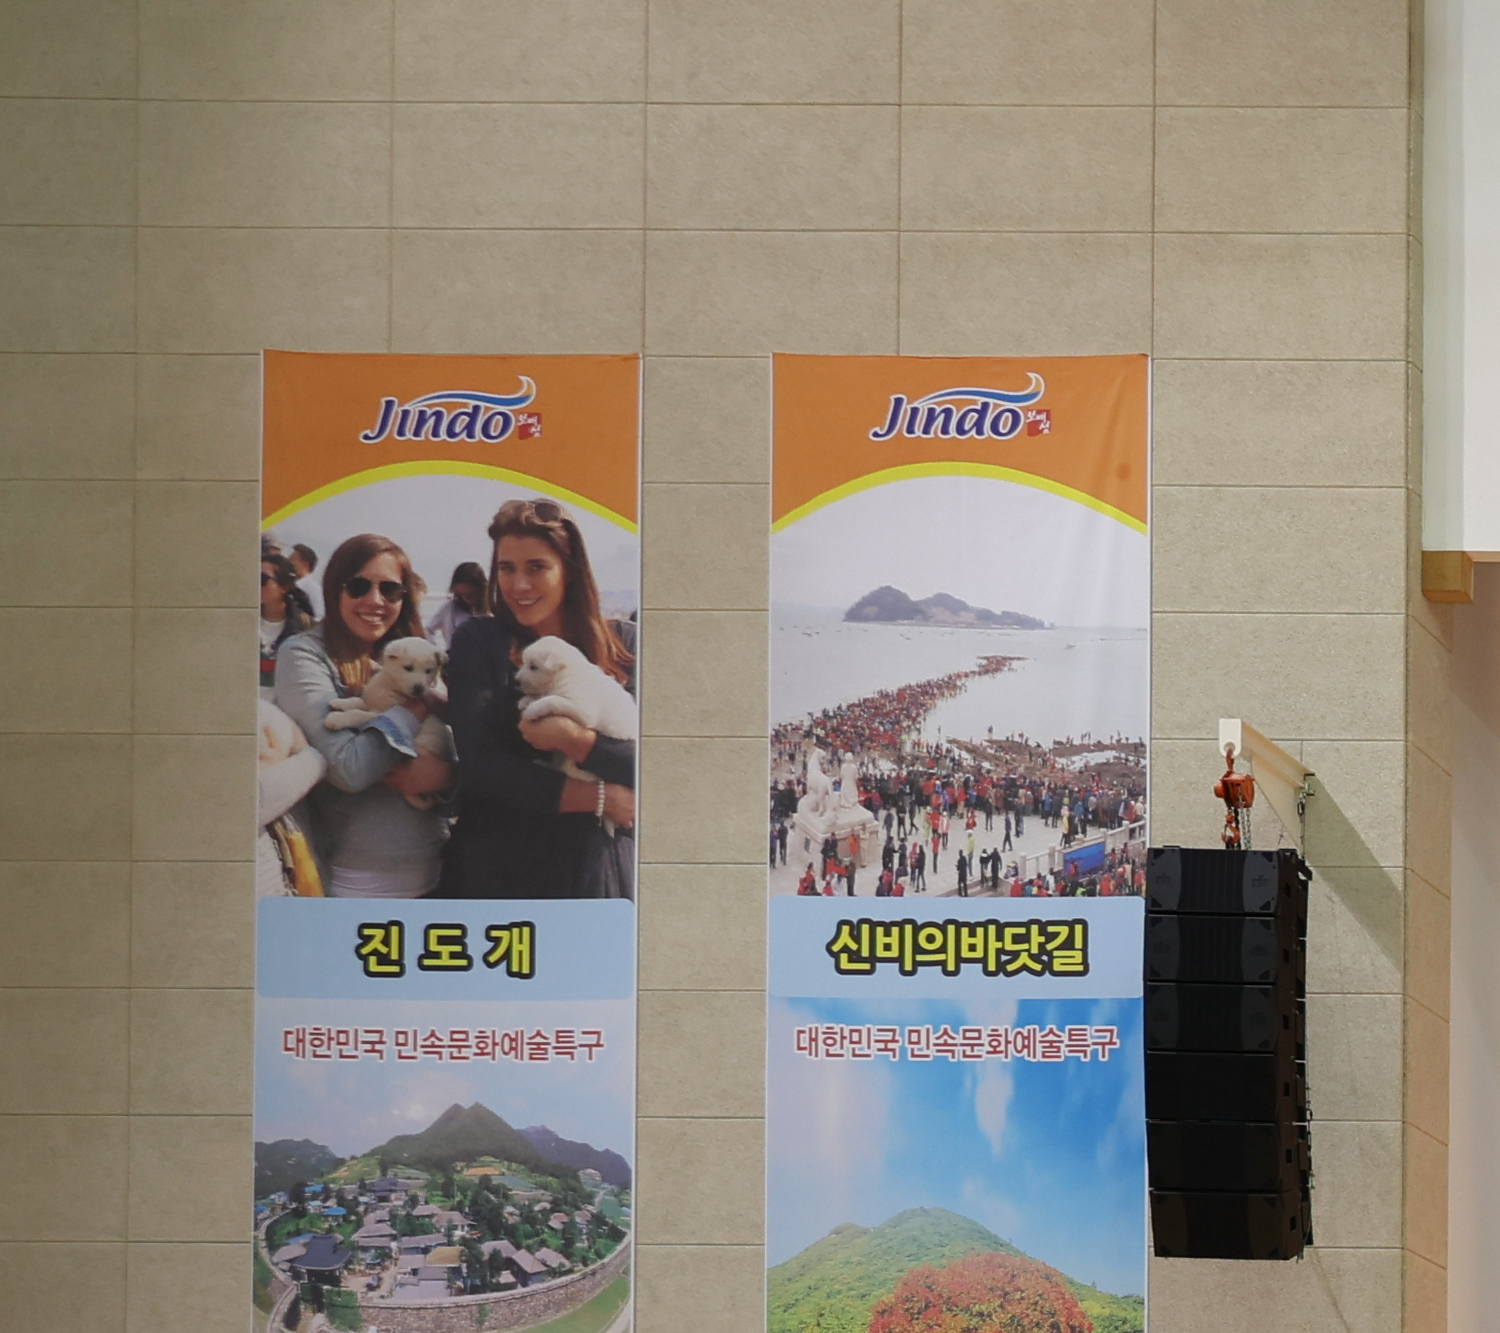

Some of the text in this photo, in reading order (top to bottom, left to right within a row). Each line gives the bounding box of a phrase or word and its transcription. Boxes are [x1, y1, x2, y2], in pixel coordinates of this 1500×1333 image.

[361, 396, 515, 443] Jindo
[872, 394, 1024, 440] Jindo
[829, 919, 1088, 975] 신비의바닷길
[283, 1026, 604, 1063] 대한민국 민속문화예술특구
[795, 1025, 1118, 1062] 대한민국 민속문화예술특구
